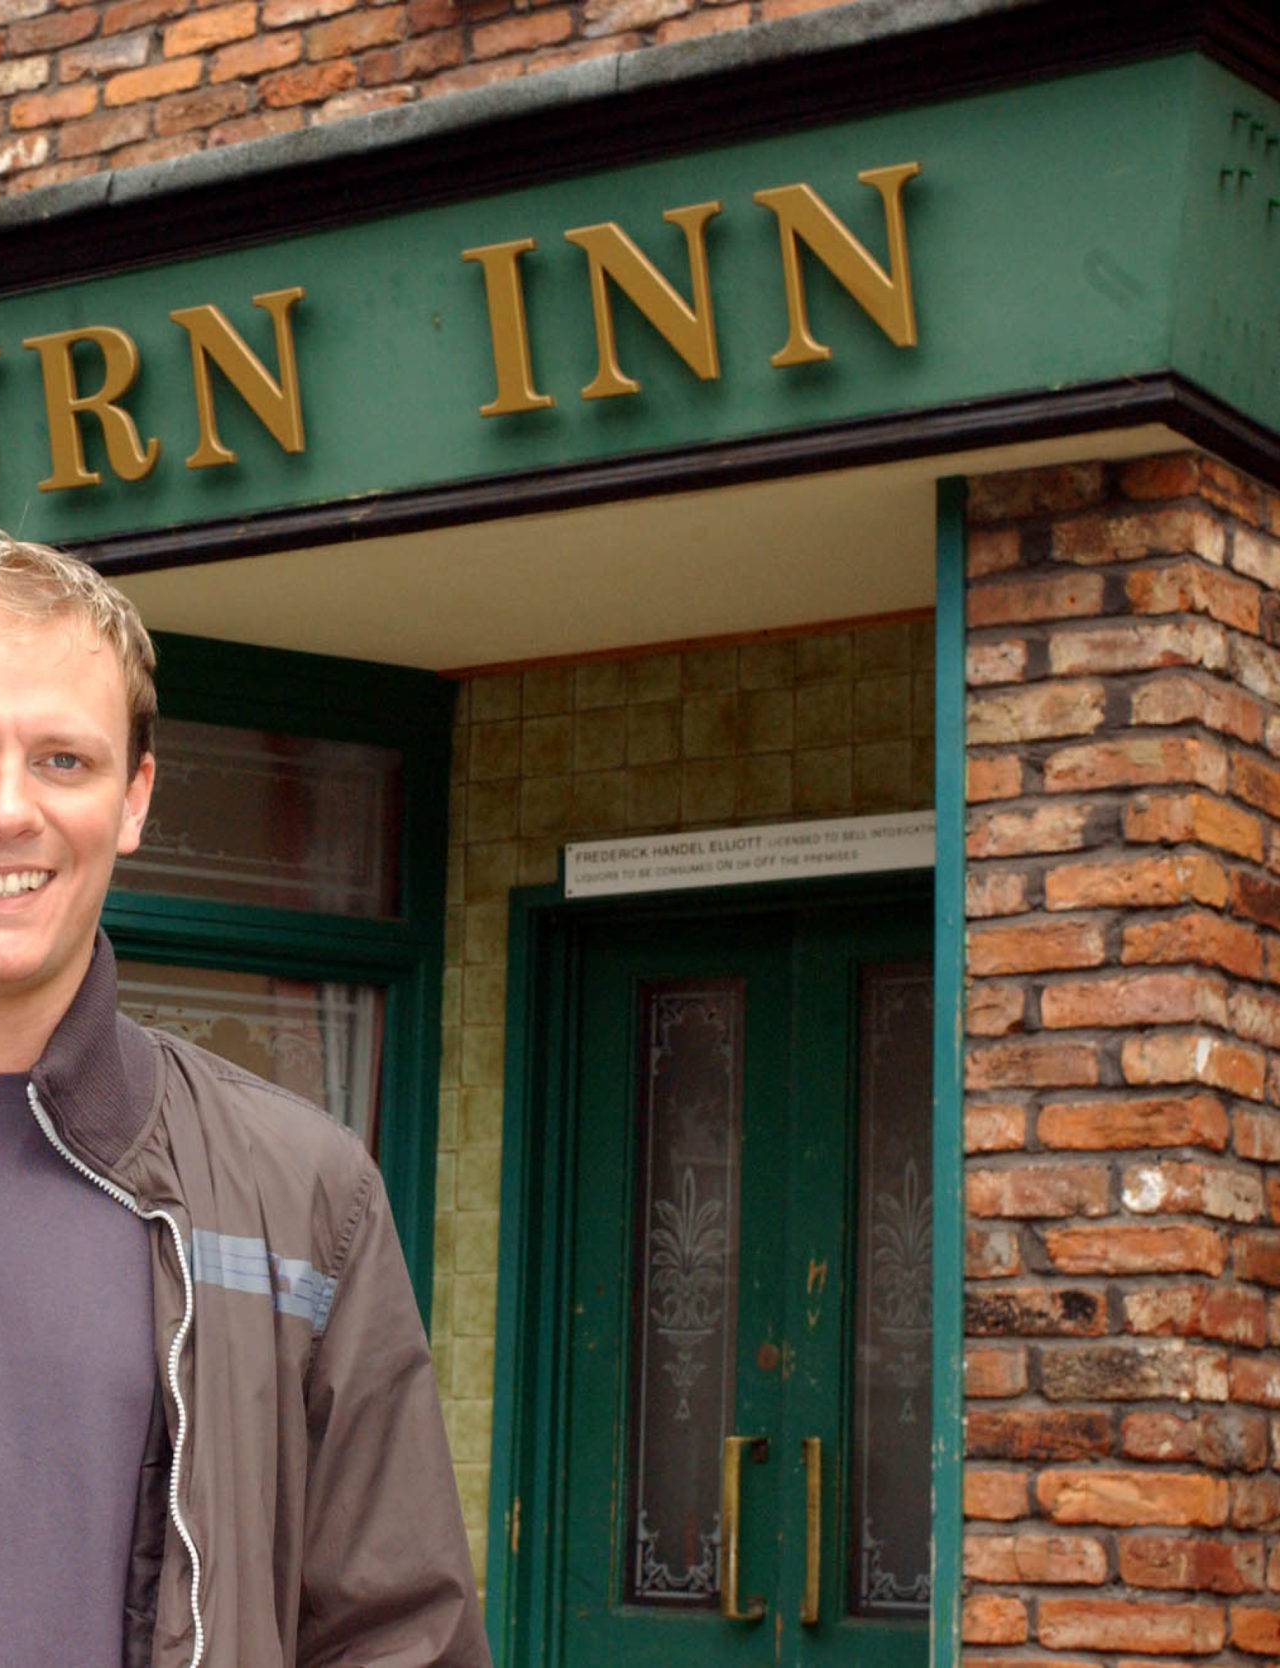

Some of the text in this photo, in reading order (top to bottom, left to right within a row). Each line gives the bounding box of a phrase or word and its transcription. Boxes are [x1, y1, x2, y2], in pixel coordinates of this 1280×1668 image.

[462, 162, 922, 417] INN
[575, 847, 649, 864] FREDERICK
[653, 842, 706, 857] HANDEL
[709, 836, 762, 853] ELLIOTT
[824, 831, 839, 842] TO
[622, 868, 636, 880] TO
[638, 867, 652, 879] BE
[716, 858, 733, 871] ON
[753, 854, 777, 869] OFF
[780, 854, 799, 867] THE
